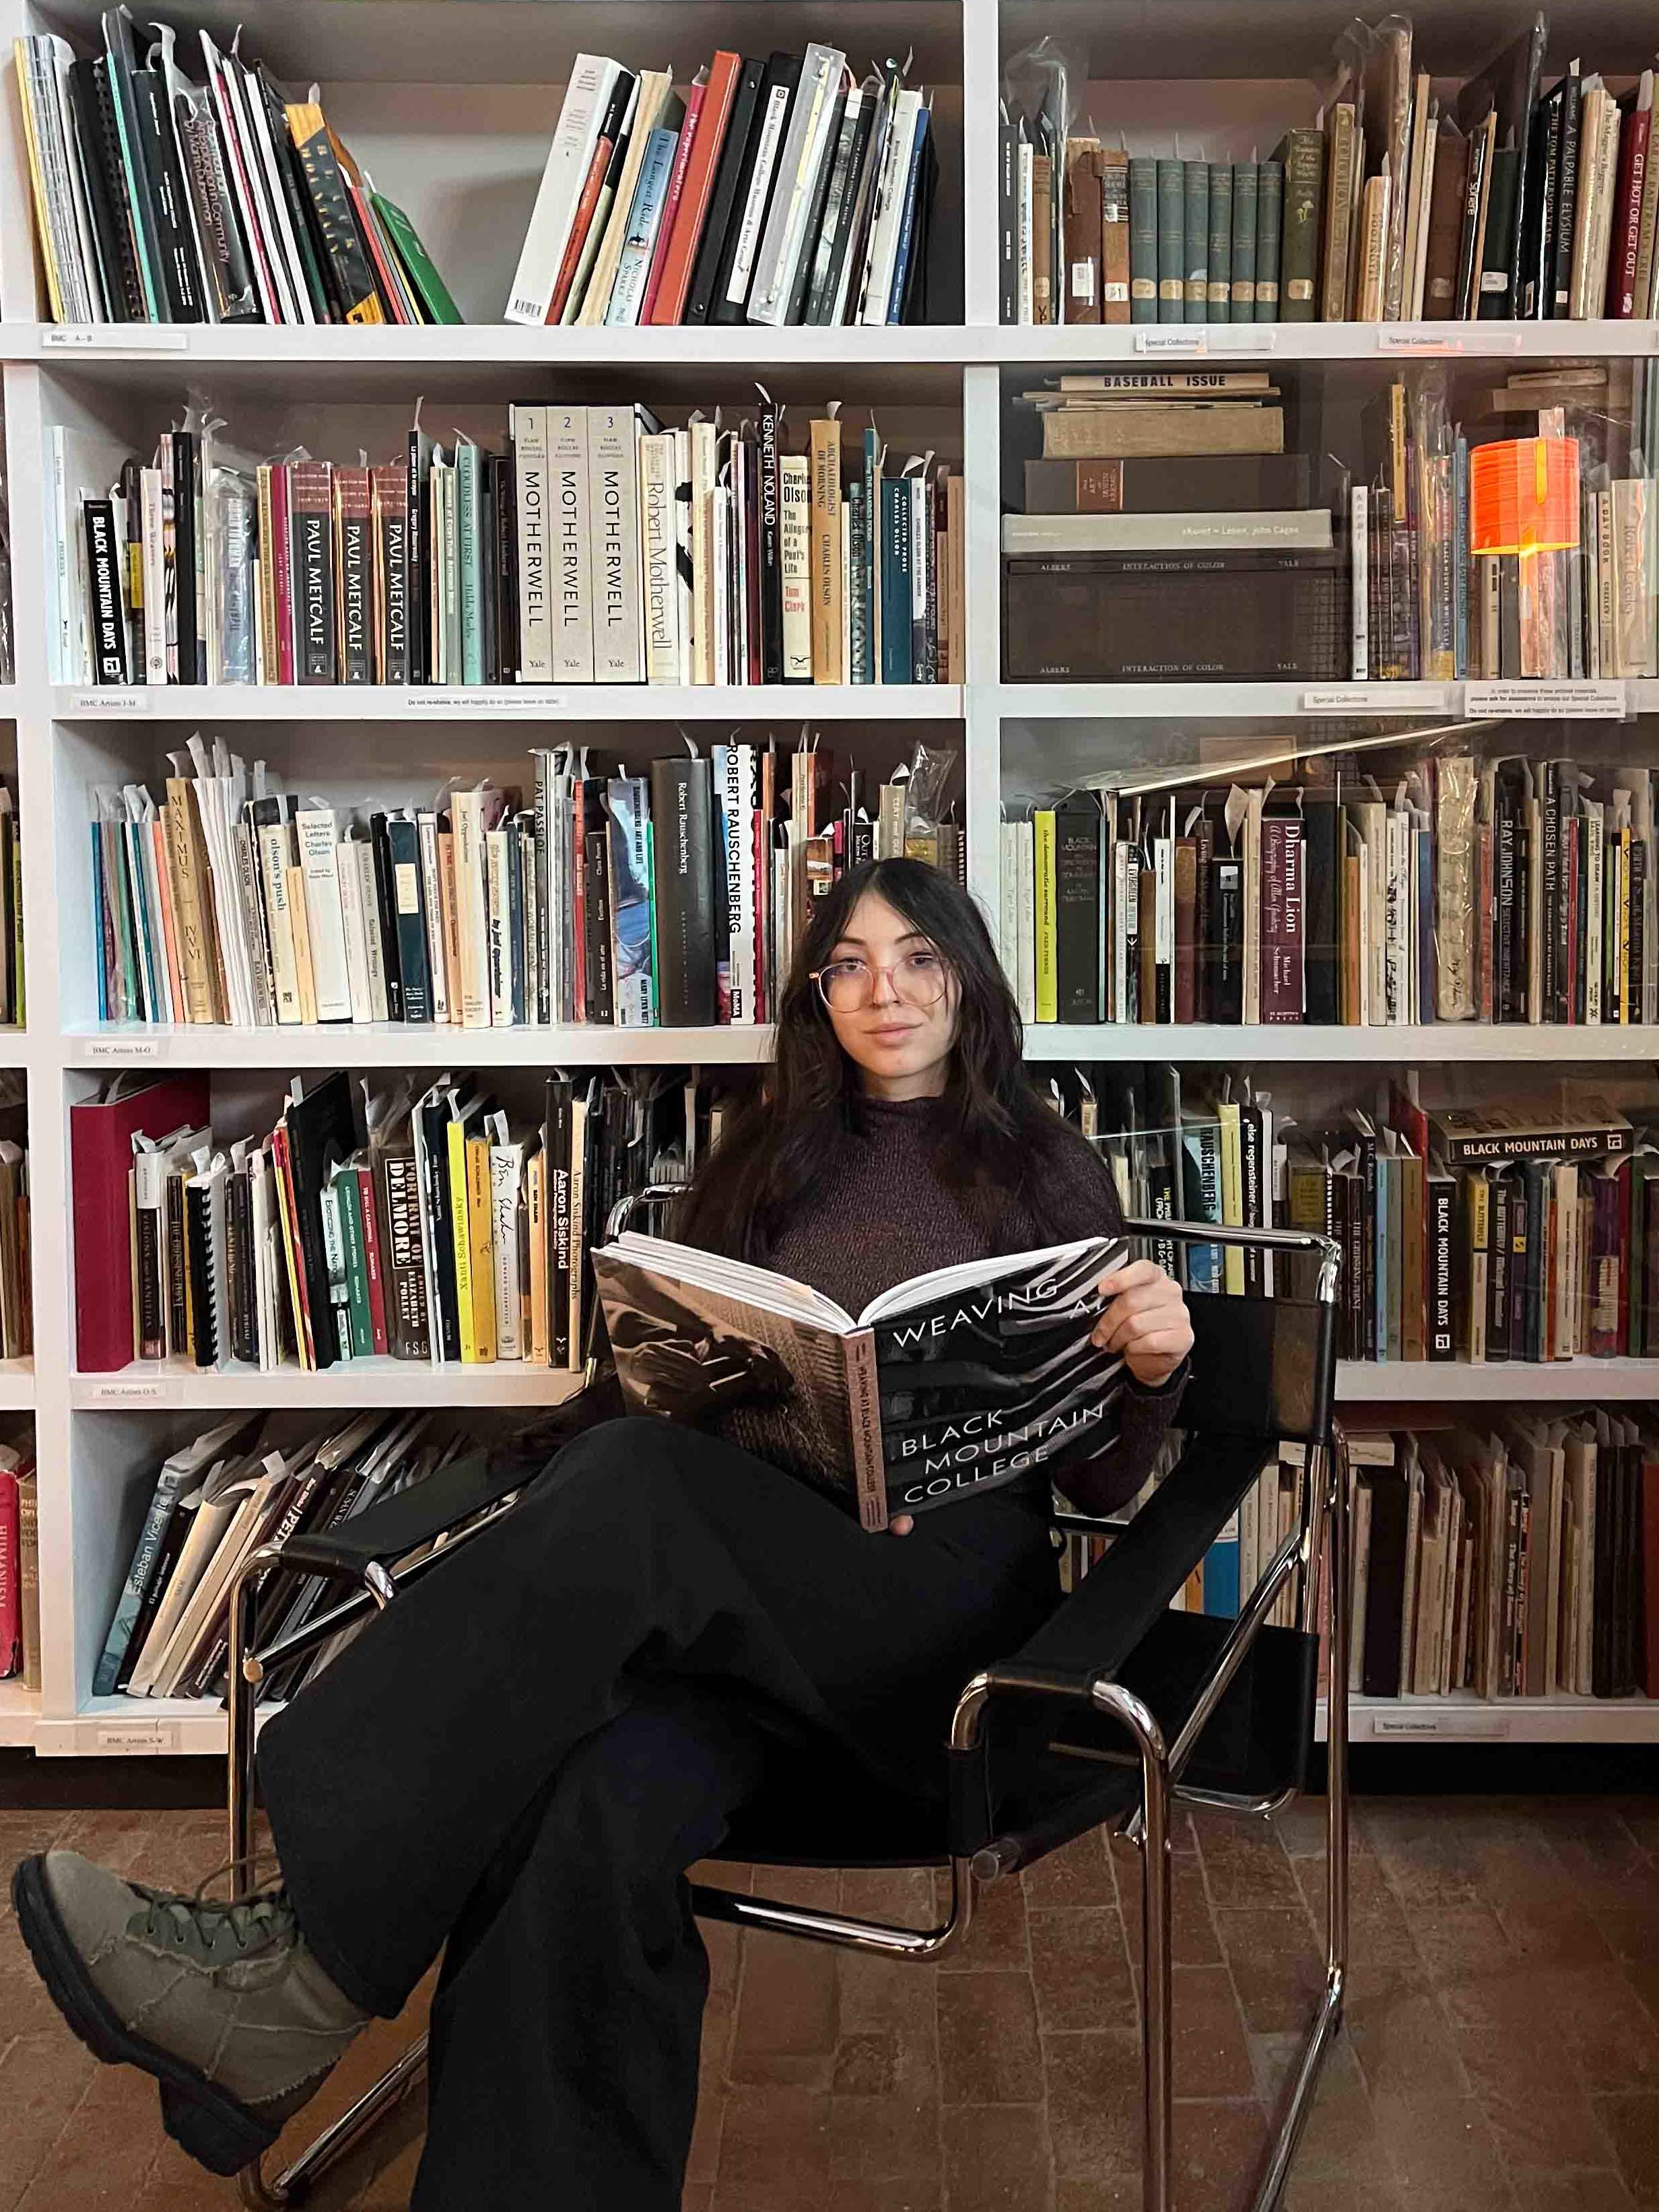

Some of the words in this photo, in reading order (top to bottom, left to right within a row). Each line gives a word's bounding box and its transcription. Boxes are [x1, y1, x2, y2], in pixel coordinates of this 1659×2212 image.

[768, 100, 781, 121] Black
[1550, 112, 1559, 131] THE
[761, 122, 776, 158] Mountain
[1566, 125, 1576, 135] A
[1549, 135, 1558, 158] TOM
[646, 160, 664, 198] Longest
[753, 160, 768, 187] College
[1562, 140, 1576, 195] PALPABLE
[1633, 154, 1644, 178] GET
[1466, 181, 1479, 216] Sphere
[1546, 158, 1557, 213] PATTERSON
[1631, 179, 1643, 207] HOT
[638, 203, 656, 229] Ride
[747, 187, 761, 218] Museum
[1629, 207, 1640, 224] OR
[742, 227, 752, 244] Arts
[1545, 215, 1554, 244] YEARS
[1560, 202, 1573, 254] ELYSIUM
[1627, 226, 1638, 250] GET
[736, 244, 747, 269] Center
[1625, 251, 1636, 277] OUT
[1104, 376, 1174, 388] BASEBALL
[1186, 375, 1226, 387] ISSUE
[528, 417, 533, 430] 1
[564, 416, 571, 428] 2
[607, 416, 614, 428] 3
[763, 413, 775, 469] KENNETH
[817, 450, 826, 461] OF
[817, 461, 827, 508] MORNING
[827, 440, 836, 517] ARCHAEOLOGIST
[646, 481, 664, 542] Robert
[764, 475, 776, 525] NOLAND
[784, 510, 797, 521] The
[851, 496, 864, 530] Charles
[93, 516, 108, 554] BLACK
[307, 519, 322, 563] PAUL
[346, 525, 362, 569] PAUL
[388, 523, 403, 568] PAUL
[524, 471, 543, 628] MOTHERWELL
[560, 471, 578, 628] MOTHERWELL
[604, 471, 623, 628] MOTHERWELL
[784, 536, 792, 547] of
[851, 533, 864, 558] Olson
[784, 549, 805, 562] Poet's
[784, 563, 798, 574] Life
[822, 533, 831, 575] CHARLES
[96, 558, 114, 618] MOUNTAIN
[649, 546, 672, 649] Motherwell
[784, 586, 800, 597] Tom
[822, 575, 832, 606] OLSON
[308, 567, 324, 645] METCALF
[347, 573, 363, 651] METCALF
[389, 572, 405, 651] METCALF
[784, 601, 806, 613] Clark
[102, 622, 116, 649] DAYS
[529, 659, 545, 669] Yale
[564, 659, 580, 669] Yale
[608, 659, 625, 669] Yale
[1040, 666, 1071, 674] ALBERS
[1122, 664, 1180, 673] INTERACTION
[1182, 664, 1194, 672] OF
[1196, 663, 1224, 672] COLOR
[1277, 662, 1297, 671] YALE
[726, 744, 739, 805] ROBERT
[535, 780, 544, 801] PAT
[677, 782, 689, 811] Robert
[171, 795, 191, 878] MAXIMUS
[301, 821, 333, 831] Selected
[305, 830, 332, 838] Letters
[535, 805, 546, 854] PASSLOF
[1270, 825, 1280, 834] A
[1501, 819, 1514, 846] RAY
[240, 840, 250, 866] CHARLES
[269, 838, 283, 879] olson's
[305, 840, 333, 850] Charles
[308, 848, 332, 857] Olson
[678, 813, 690, 874] Rauschenberg
[1198, 838, 1210, 863] Living
[1264, 834, 1281, 875] Biography
[1285, 825, 1300, 891] Dharma
[242, 867, 251, 887] OLSON
[726, 808, 742, 934] RAUSCHENBERG
[1265, 875, 1282, 883] of
[1501, 848, 1514, 906] JOHNSON
[272, 882, 287, 912] push
[1269, 883, 1282, 903] Allen
[1285, 896, 1301, 933] Lion
[1273, 945, 1282, 995] Schumacher
[1283, 956, 1291, 986] Michael
[732, 991, 741, 1017] MoMA
[1463, 1142, 1500, 1156] BLACK
[1504, 1139, 1567, 1154] MOUNTAIN
[1570, 1137, 1598, 1149] DAYS
[496, 1155, 514, 1188] Ben
[572, 1170, 581, 1199] Aaron
[1199, 1128, 1217, 1211] RAUSCHENBERG
[405, 1161, 421, 1237] PORTRAIT
[557, 1169, 569, 1214] Aaron
[1163, 1186, 1172, 1202] THE
[388, 1162, 411, 1265] DELMORE
[456, 1196, 467, 1259] Schawinsky
[498, 1197, 512, 1245] Shahn
[572, 1201, 582, 1237] Siskind
[1437, 1198, 1449, 1233] BLACK
[411, 1244, 423, 1264] OF
[557, 1216, 570, 1269] Siskind
[459, 1261, 468, 1291] Xanti
[569, 1239, 581, 1300] Photographs
[1437, 1237, 1449, 1296] MOUNTAIN
[399, 1281, 410, 1321] POLLET
[408, 1271, 419, 1328] ELIZABETH
[417, 1274, 426, 1306] EDITED
[420, 1312, 426, 1323] BY
[893, 1279, 1058, 1347] WEAVING
[1437, 1300, 1448, 1326] DAYS
[858, 1366, 869, 1398] WEAVING
[860, 1399, 870, 1407] AT
[861, 1408, 871, 1429] BLACK
[862, 1430, 873, 1465] MOUNTAIN
[902, 1409, 1003, 1457] BLACK
[925, 1404, 1104, 1475] MOUNTAIN
[865, 1466, 877, 1493] COLLEGE
[904, 1445, 1048, 1503] COLLEGE
[131, 1543, 155, 1595] Esteban
[1382, 1722, 1404, 1731] Special
